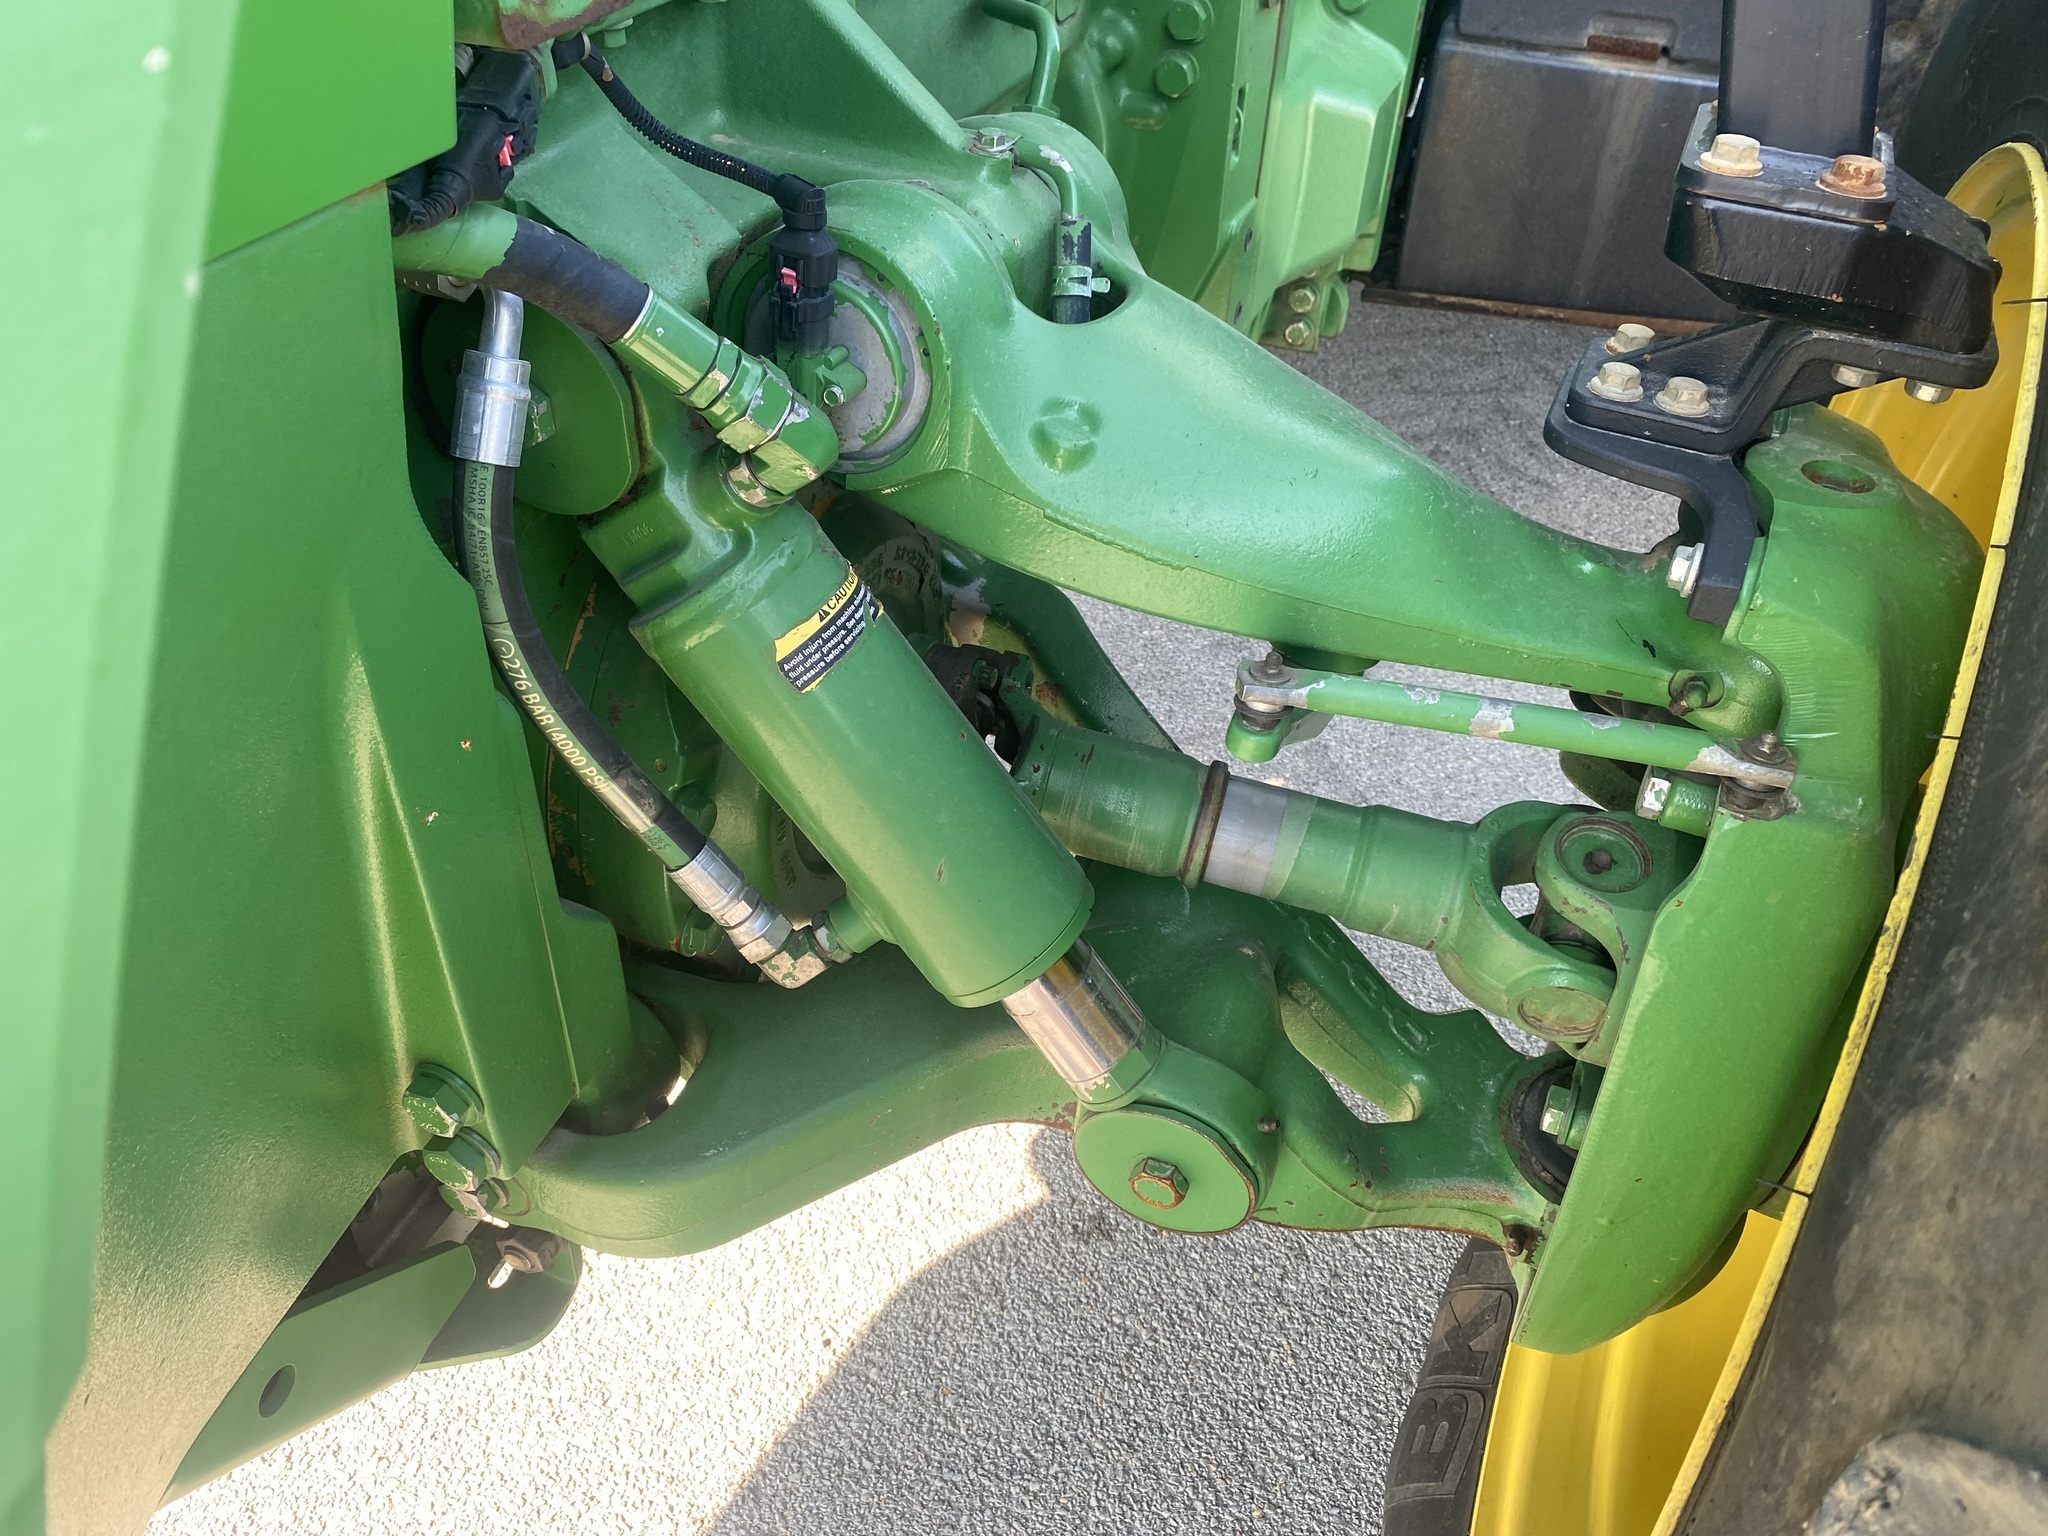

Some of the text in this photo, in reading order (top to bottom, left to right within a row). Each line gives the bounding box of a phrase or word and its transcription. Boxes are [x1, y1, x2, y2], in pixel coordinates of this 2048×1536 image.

[468, 466, 479, 504] MSHA
[477, 477, 488, 520] 100R16
[477, 530, 489, 564] EN857
[482, 568, 494, 586] 2SC
[783, 652, 805, 672] Avoid
[802, 637, 824, 656] injury
[821, 624, 838, 640] from
[835, 604, 856, 627] machine
[788, 664, 805, 679] fluid
[803, 650, 823, 668] under
[821, 629, 848, 655] pressure.
[845, 617, 856, 629] See
[794, 620, 866, 688] pressure before servicing
[502, 658, 613, 793] 276 BAR (4000 PSI)
